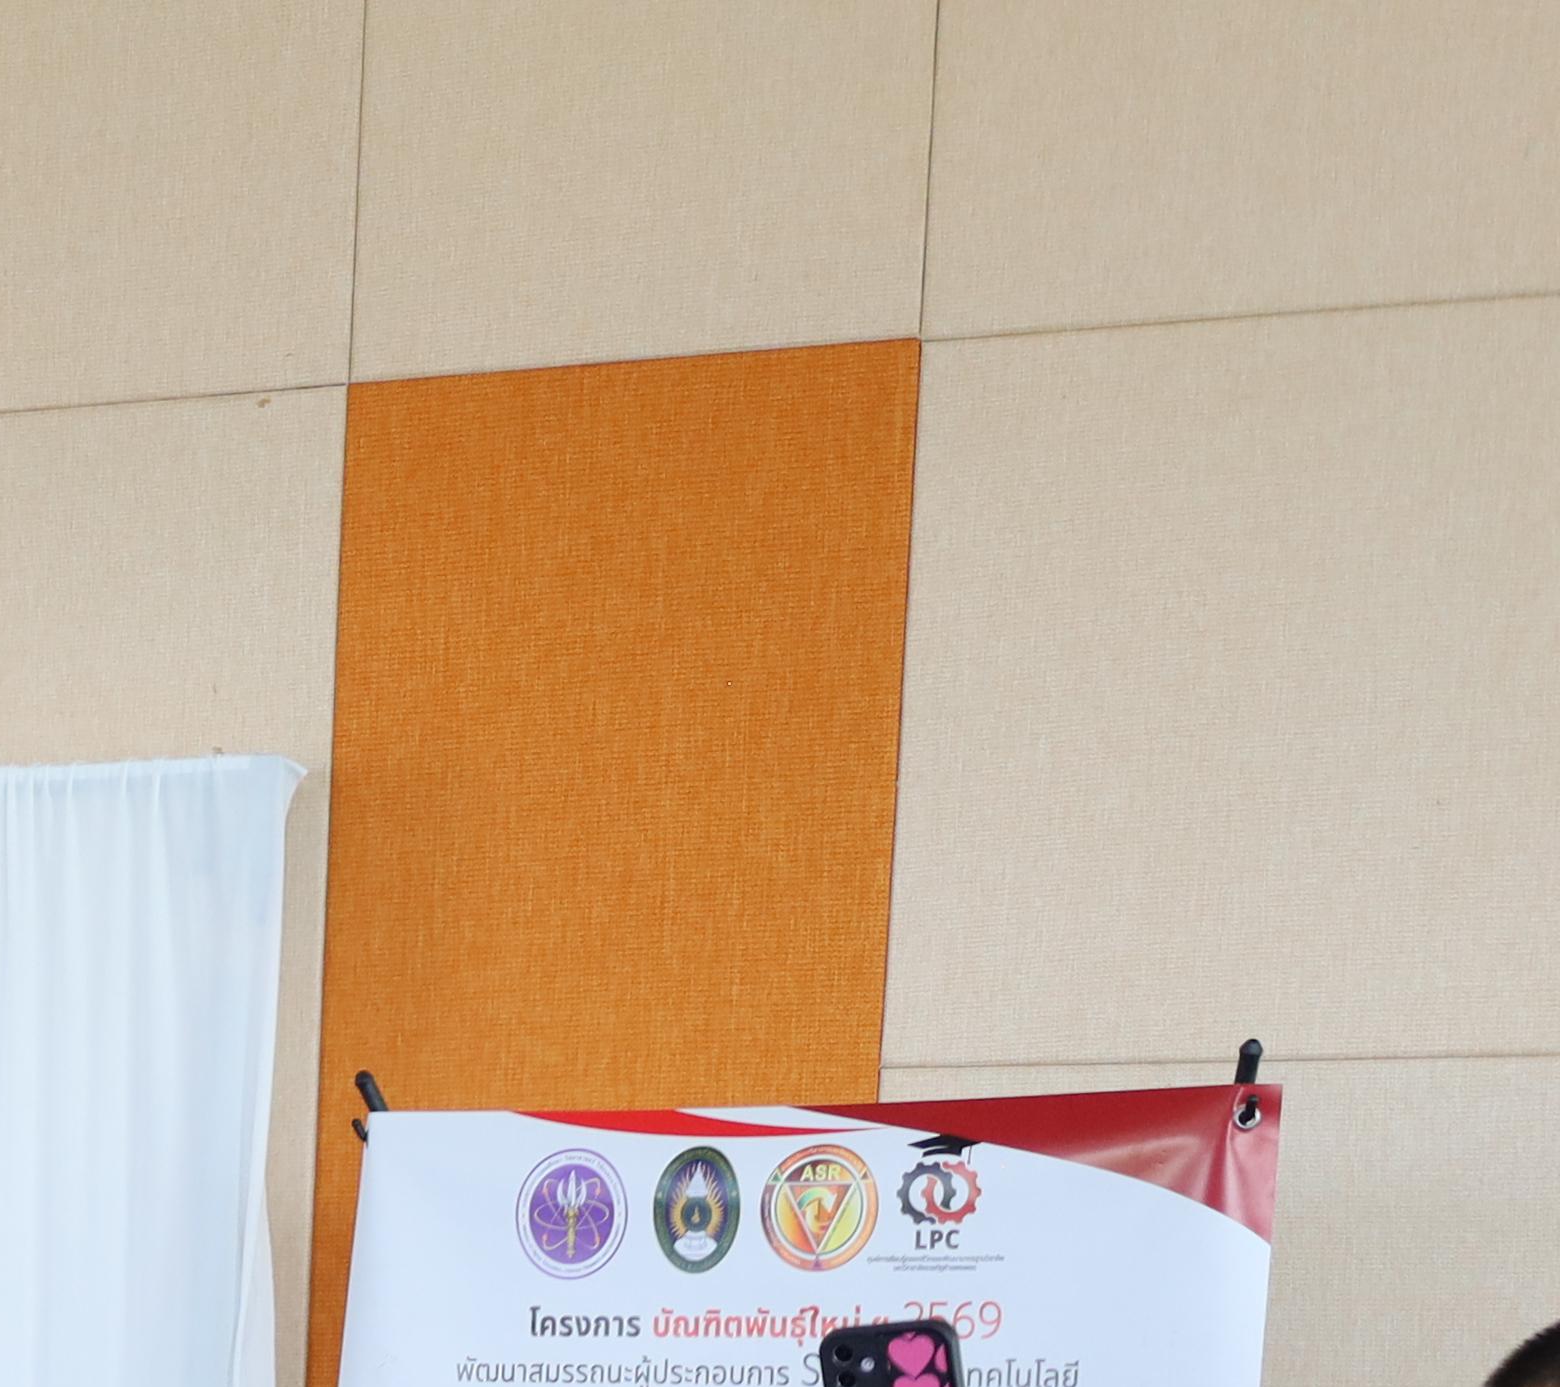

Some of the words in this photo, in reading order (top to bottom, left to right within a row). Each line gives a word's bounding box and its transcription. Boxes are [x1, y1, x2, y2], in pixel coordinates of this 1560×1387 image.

[799, 1163, 841, 1183] ASR
[914, 1230, 961, 1251] LPC
[528, 1306, 641, 1339] โครงการ
